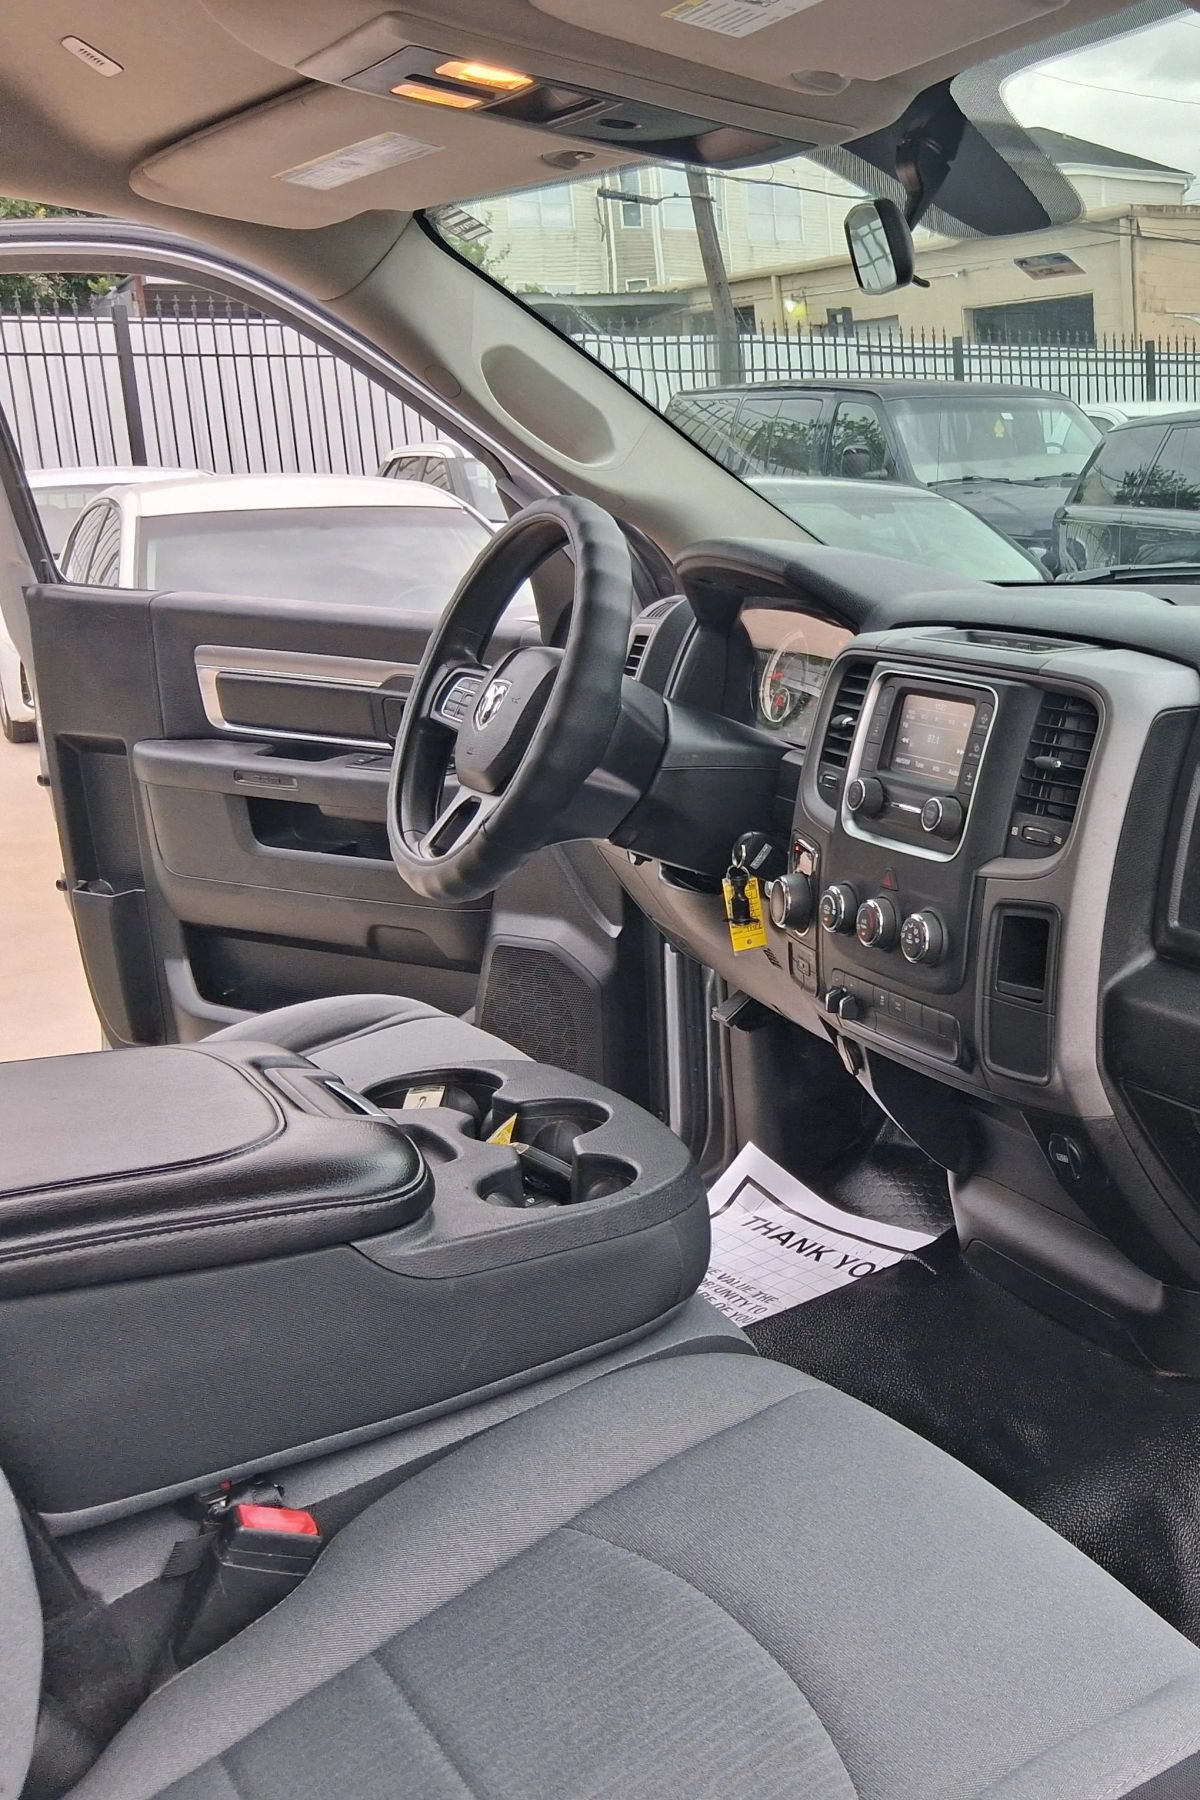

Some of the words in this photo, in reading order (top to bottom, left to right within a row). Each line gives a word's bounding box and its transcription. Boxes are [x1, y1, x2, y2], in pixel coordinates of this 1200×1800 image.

[741, 1216, 836, 1262] THANK
[716, 1272, 757, 1294] VALUE
[751, 1290, 780, 1304] THE
[729, 1311, 759, 1325] YOU
[748, 1304, 769, 1316] TO
